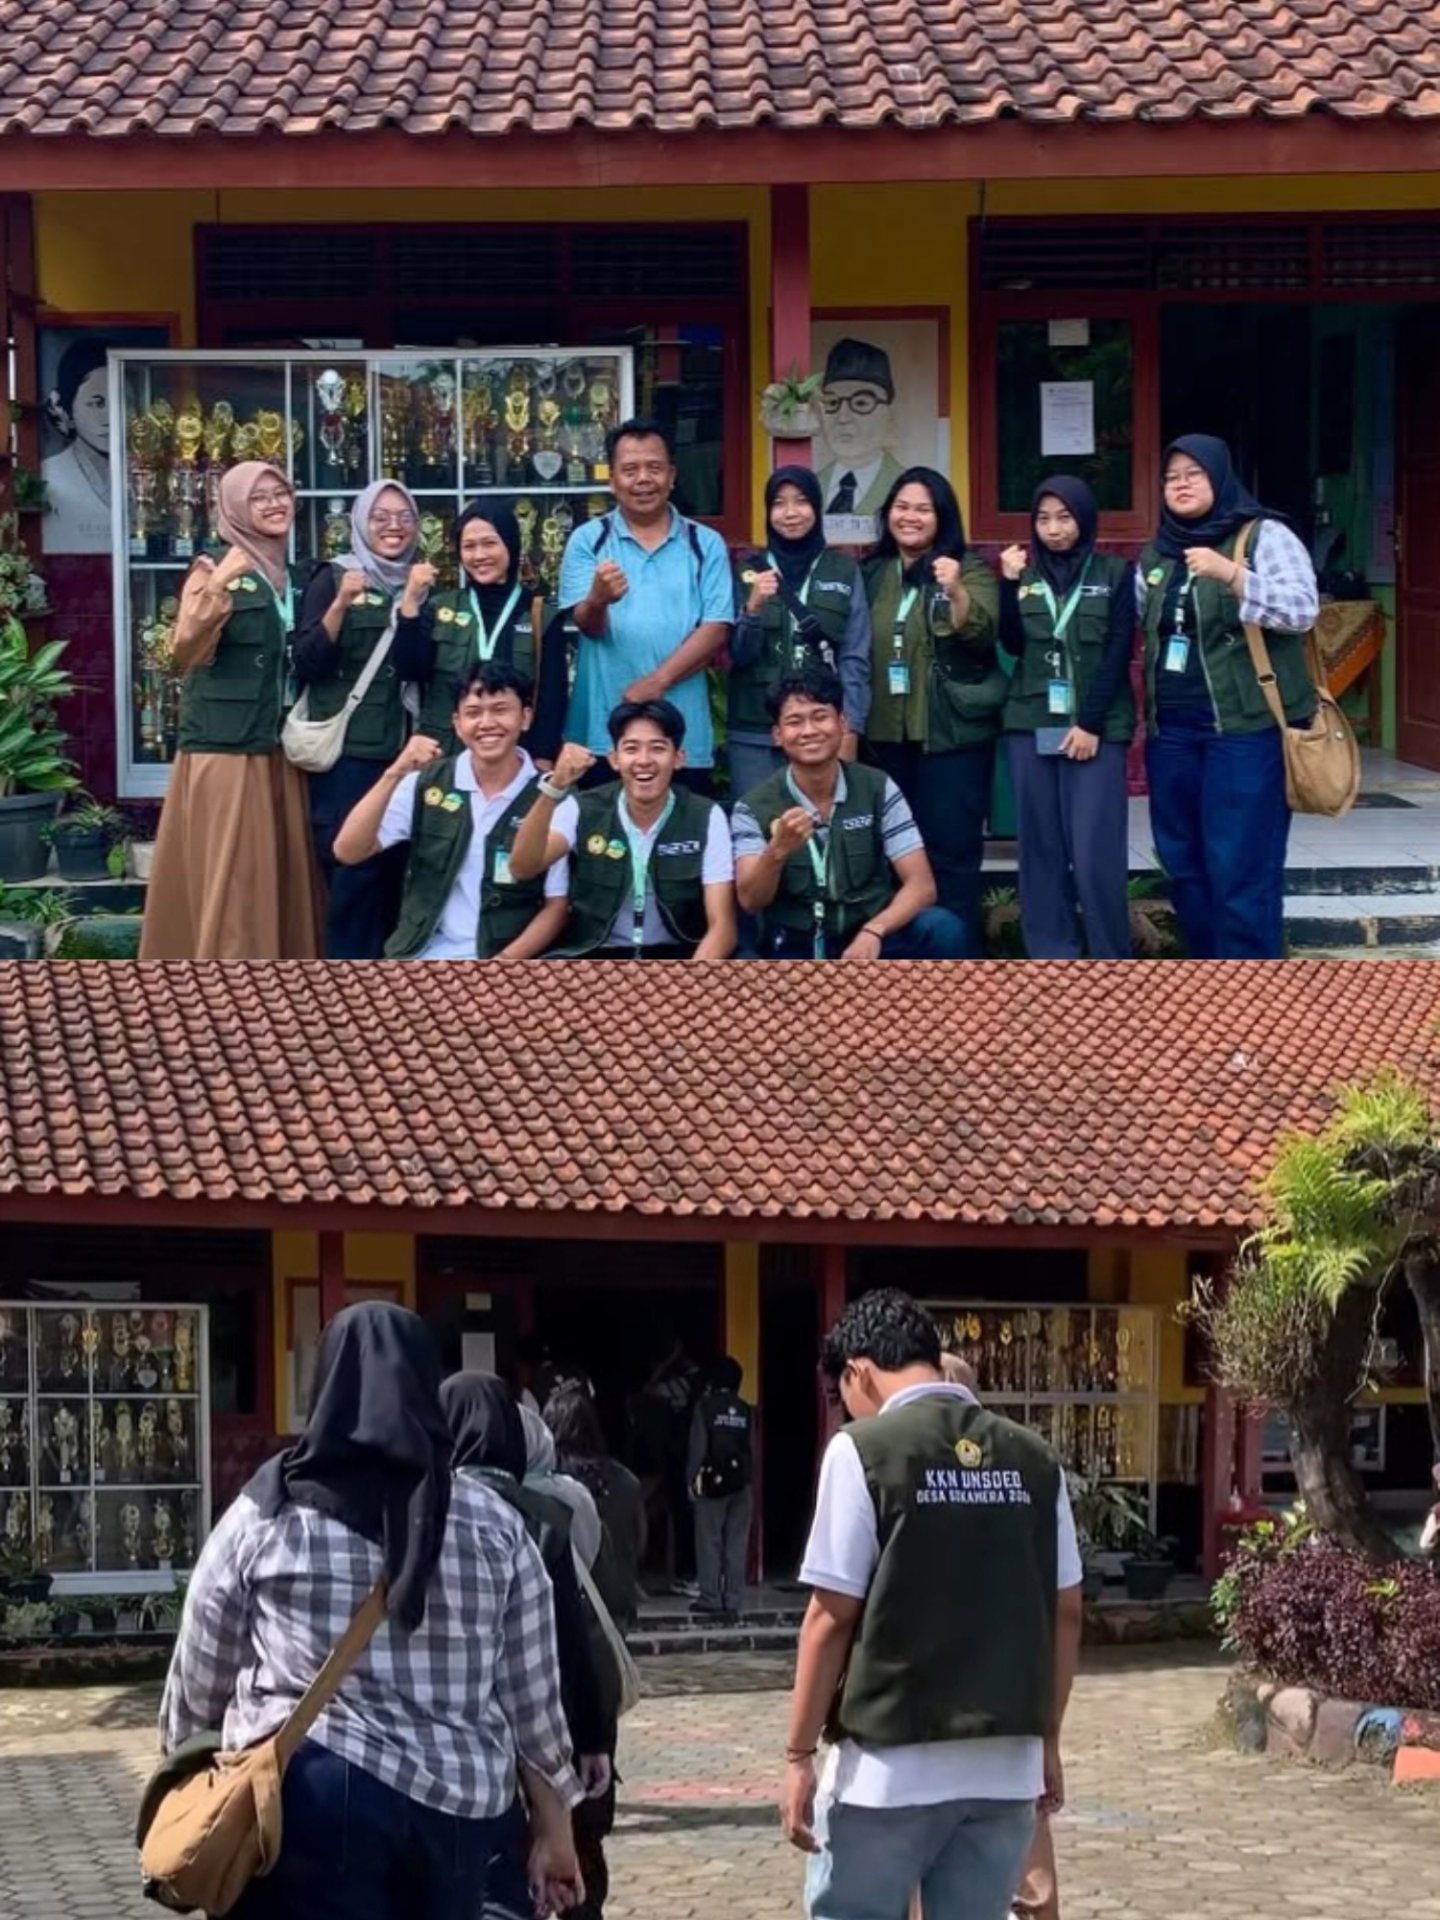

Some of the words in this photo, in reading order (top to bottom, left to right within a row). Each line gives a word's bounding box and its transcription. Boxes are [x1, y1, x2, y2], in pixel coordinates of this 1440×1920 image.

[926, 1469, 958, 1488] KKN
[961, 1470, 1022, 1489] UNSOED
[916, 1489, 947, 1504] DESA
